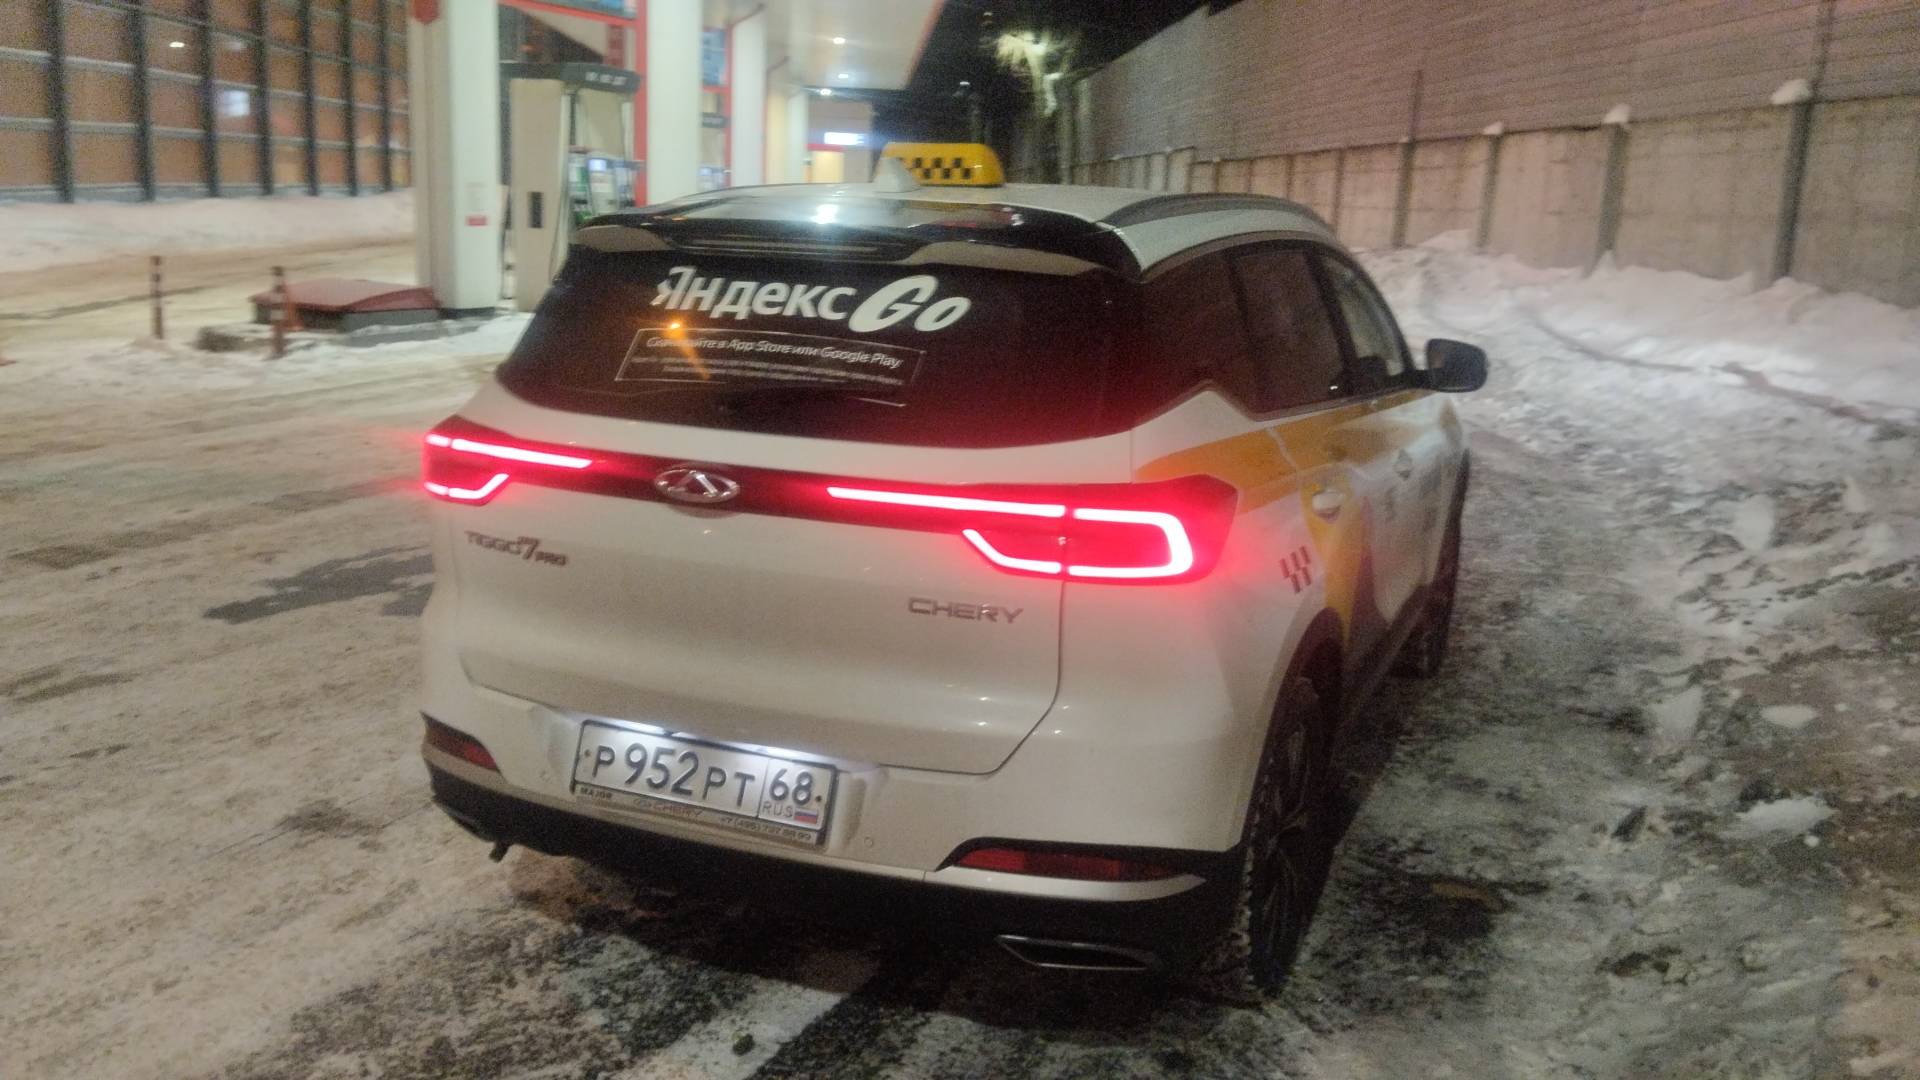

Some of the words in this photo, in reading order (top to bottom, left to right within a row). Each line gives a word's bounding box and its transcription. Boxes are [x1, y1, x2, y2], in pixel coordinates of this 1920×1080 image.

[651, 265, 857, 320] Яндекс
[848, 274, 972, 333] Go
[727, 338, 754, 353] App
[755, 340, 792, 354] Store
[820, 346, 871, 364] Google
[870, 353, 904, 370] Play
[908, 597, 1024, 624] CHERY
[768, 768, 814, 806] 68
[762, 800, 794, 819] RUS
